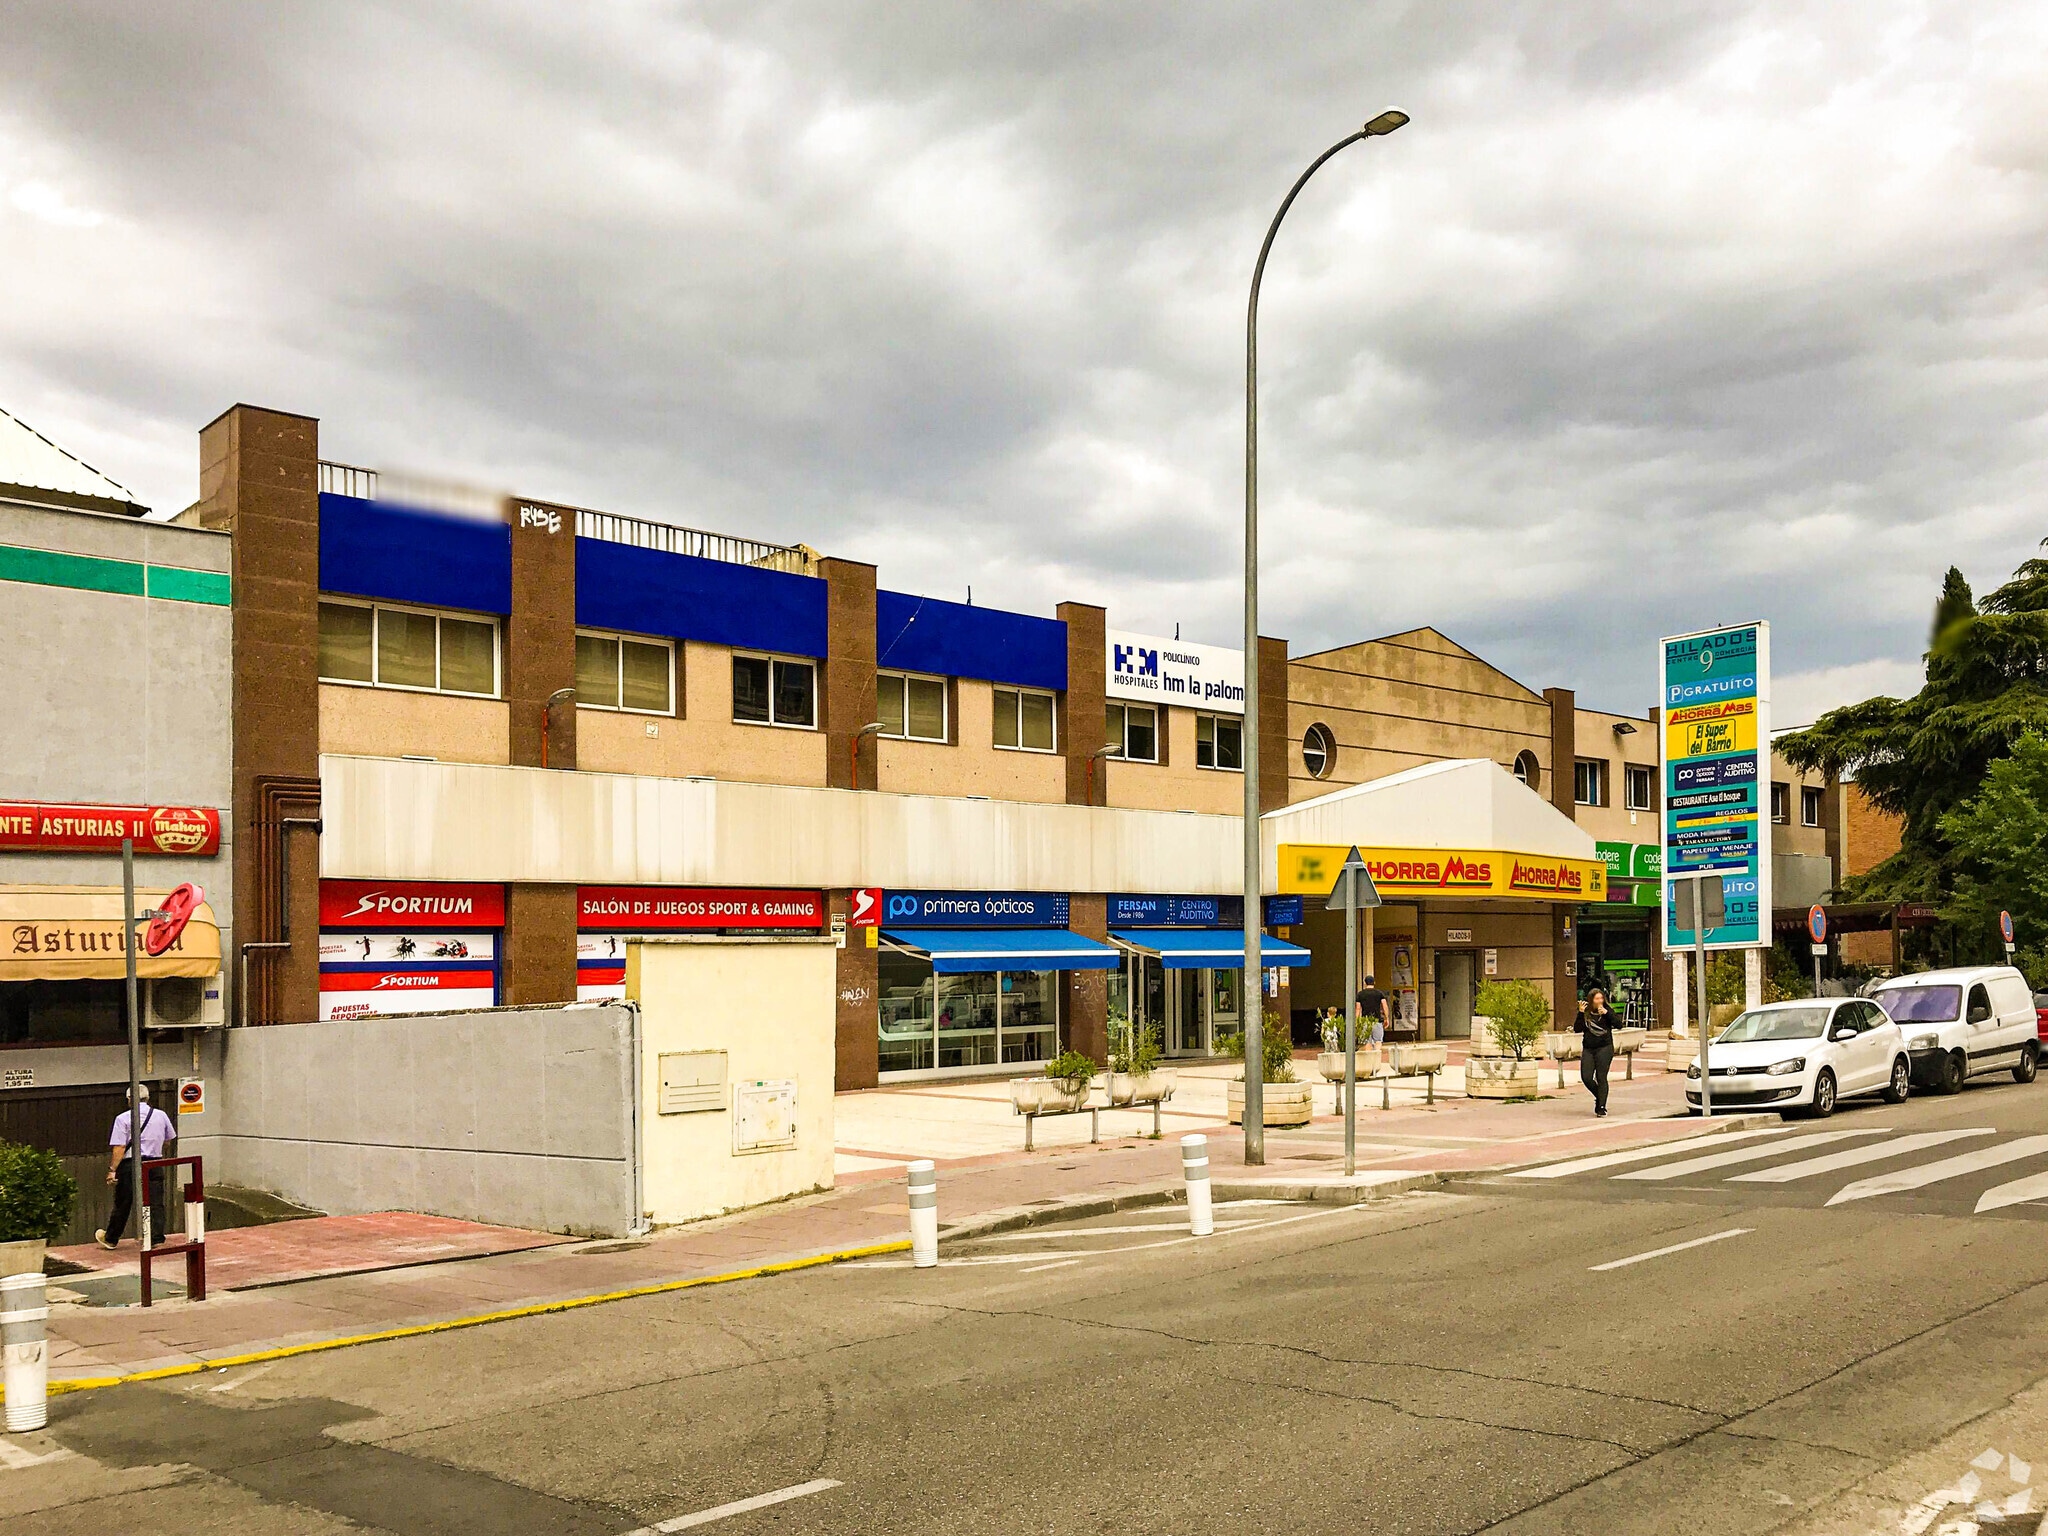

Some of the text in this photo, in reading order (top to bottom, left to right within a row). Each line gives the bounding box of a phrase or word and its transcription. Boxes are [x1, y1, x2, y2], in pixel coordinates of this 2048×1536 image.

[1666, 630, 1756, 656] HILADOS
[1163, 651, 1200, 666] POLICLÍNICO
[1700, 650, 1713, 673] 9
[1114, 674, 1159, 689] HOSPITALES
[1163, 671, 1185, 693] hm
[1189, 675, 1201, 695] la
[1683, 677, 1754, 696] GRATUÍTO
[1696, 724, 1728, 740] El Super
[1690, 736, 1731, 754] del Barrio
[1723, 767, 1756, 777] AUDITIVO
[1725, 761, 1754, 771] CENTRO
[1672, 794, 1708, 807] RESTAURANTE
[1715, 808, 1748, 816] REGALOS
[41, 818, 124, 837] ASTURIAS
[1682, 843, 1753, 855] PAPELERÍA MENAJE
[341, 890, 472, 918] SPORTIUM
[583, 897, 814, 917] SALÓN DE JUEGOS SPORT & GAMING
[924, 898, 980, 917] primera
[984, 897, 1034, 917] ópticos
[1118, 900, 1157, 911] FERSAN
[1181, 900, 1212, 910] CENTRO
[1117, 911, 1145, 919] Desde 1986
[1179, 910, 1214, 920] AUDITIVO
[13, 925, 184, 953] Asturiaa
[371, 973, 439, 989] SPORTIUM
[331, 1003, 369, 1014] APUESTAS
